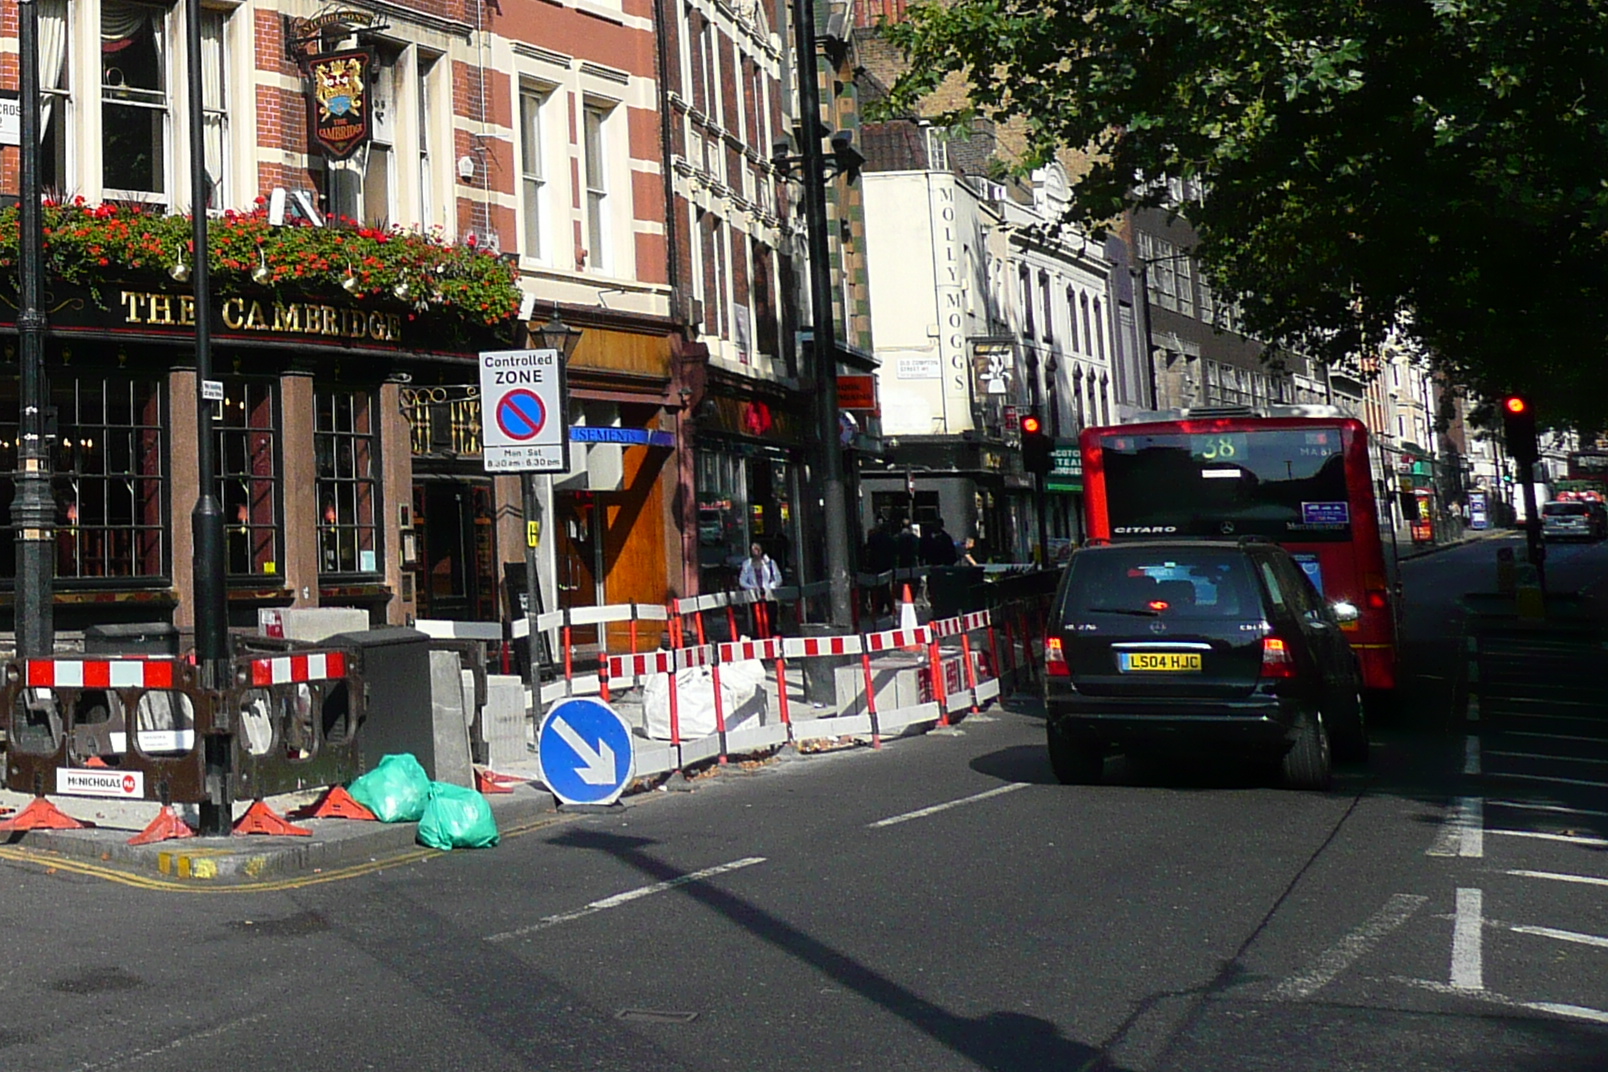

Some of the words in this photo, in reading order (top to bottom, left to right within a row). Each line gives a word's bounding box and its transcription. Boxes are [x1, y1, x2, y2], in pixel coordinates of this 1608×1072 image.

[333, 118, 349, 126] THE
[318, 124, 364, 141] CAMBRIDGE
[939, 187, 957, 281] MOLLY
[121, 290, 196, 326] THE
[222, 297, 401, 341] CAMBRIDGE
[946, 292, 965, 391] MOGGS
[484, 354, 553, 368] Controlled
[495, 370, 543, 385] ZONE
[527, 448, 542, 457] Sat
[1203, 435, 1235, 458] 38
[1114, 526, 1177, 534] CITARO
[1130, 655, 1166, 668] LS04
[1171, 655, 1199, 668] HJC
[68, 776, 121, 788] McNICHOLAS
